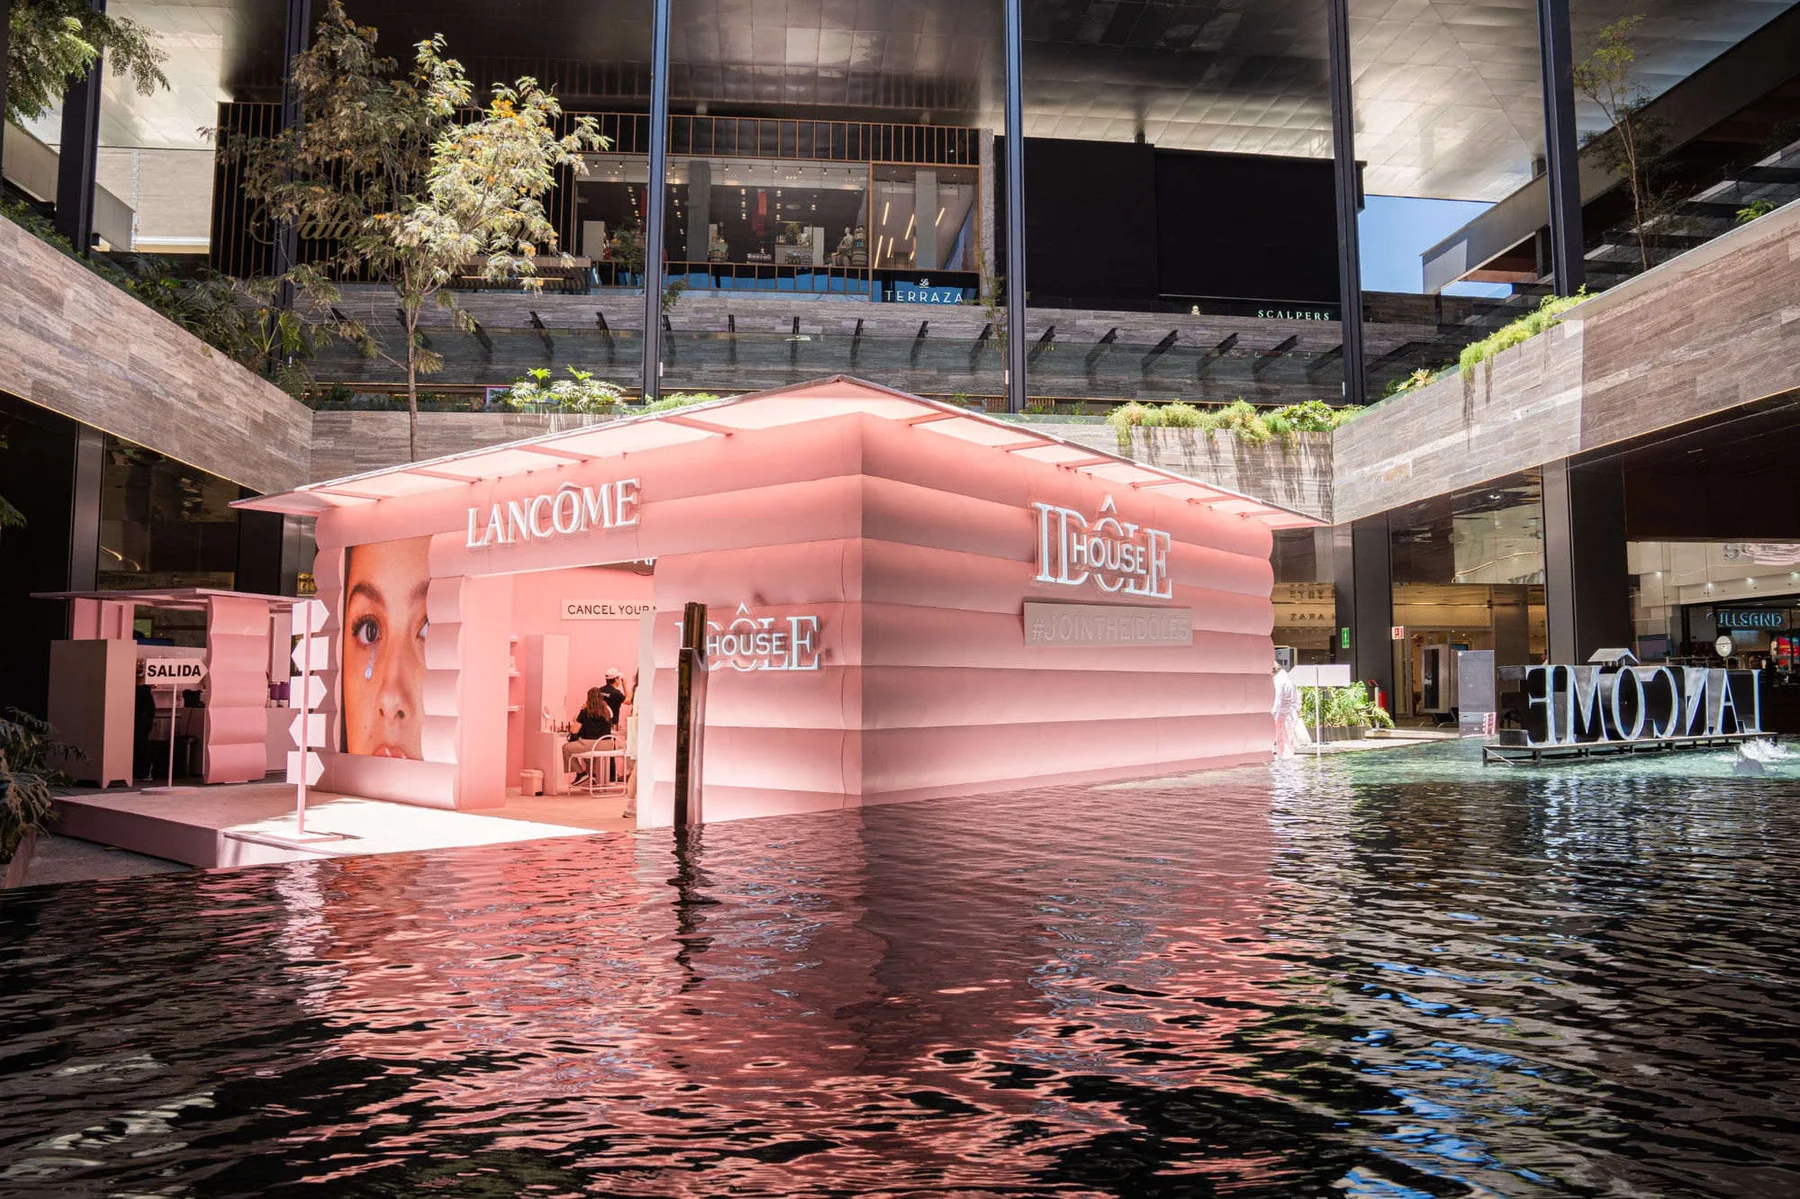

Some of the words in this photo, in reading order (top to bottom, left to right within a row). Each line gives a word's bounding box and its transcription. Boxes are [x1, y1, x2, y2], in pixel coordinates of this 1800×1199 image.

[885, 290, 963, 303] TERRAZA
[1258, 309, 1330, 321] SCALPERS
[466, 477, 640, 548] LANCÔME
[1071, 532, 1147, 575] HOUSE
[567, 604, 615, 615] CANCEL
[1290, 613, 1325, 621] ZARA
[706, 632, 787, 656] HOUSE
[147, 664, 201, 677] SALIDA
